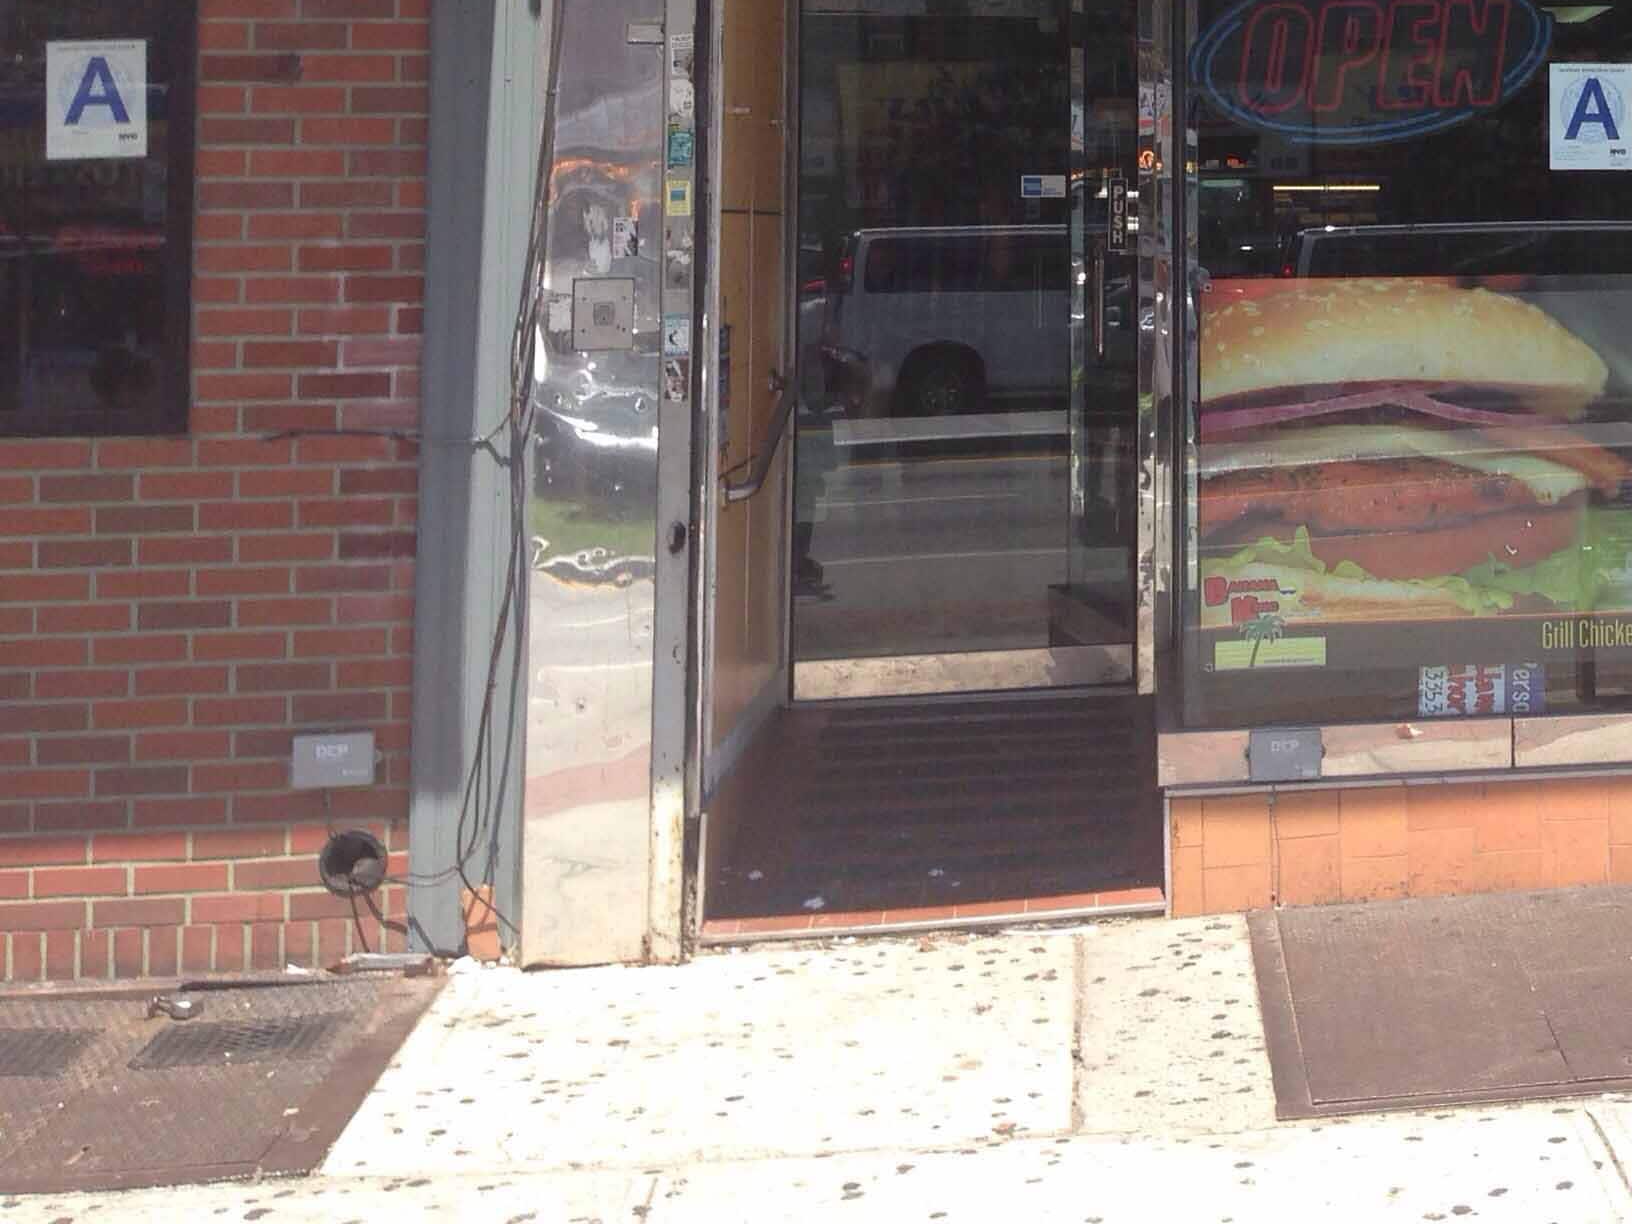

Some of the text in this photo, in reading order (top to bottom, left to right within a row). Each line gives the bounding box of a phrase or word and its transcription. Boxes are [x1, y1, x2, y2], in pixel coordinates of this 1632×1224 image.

[64, 56, 131, 126] A
[1563, 78, 1620, 140] A
[1112, 184, 1124, 245] PUSH
[1542, 620, 1574, 649] Grill
